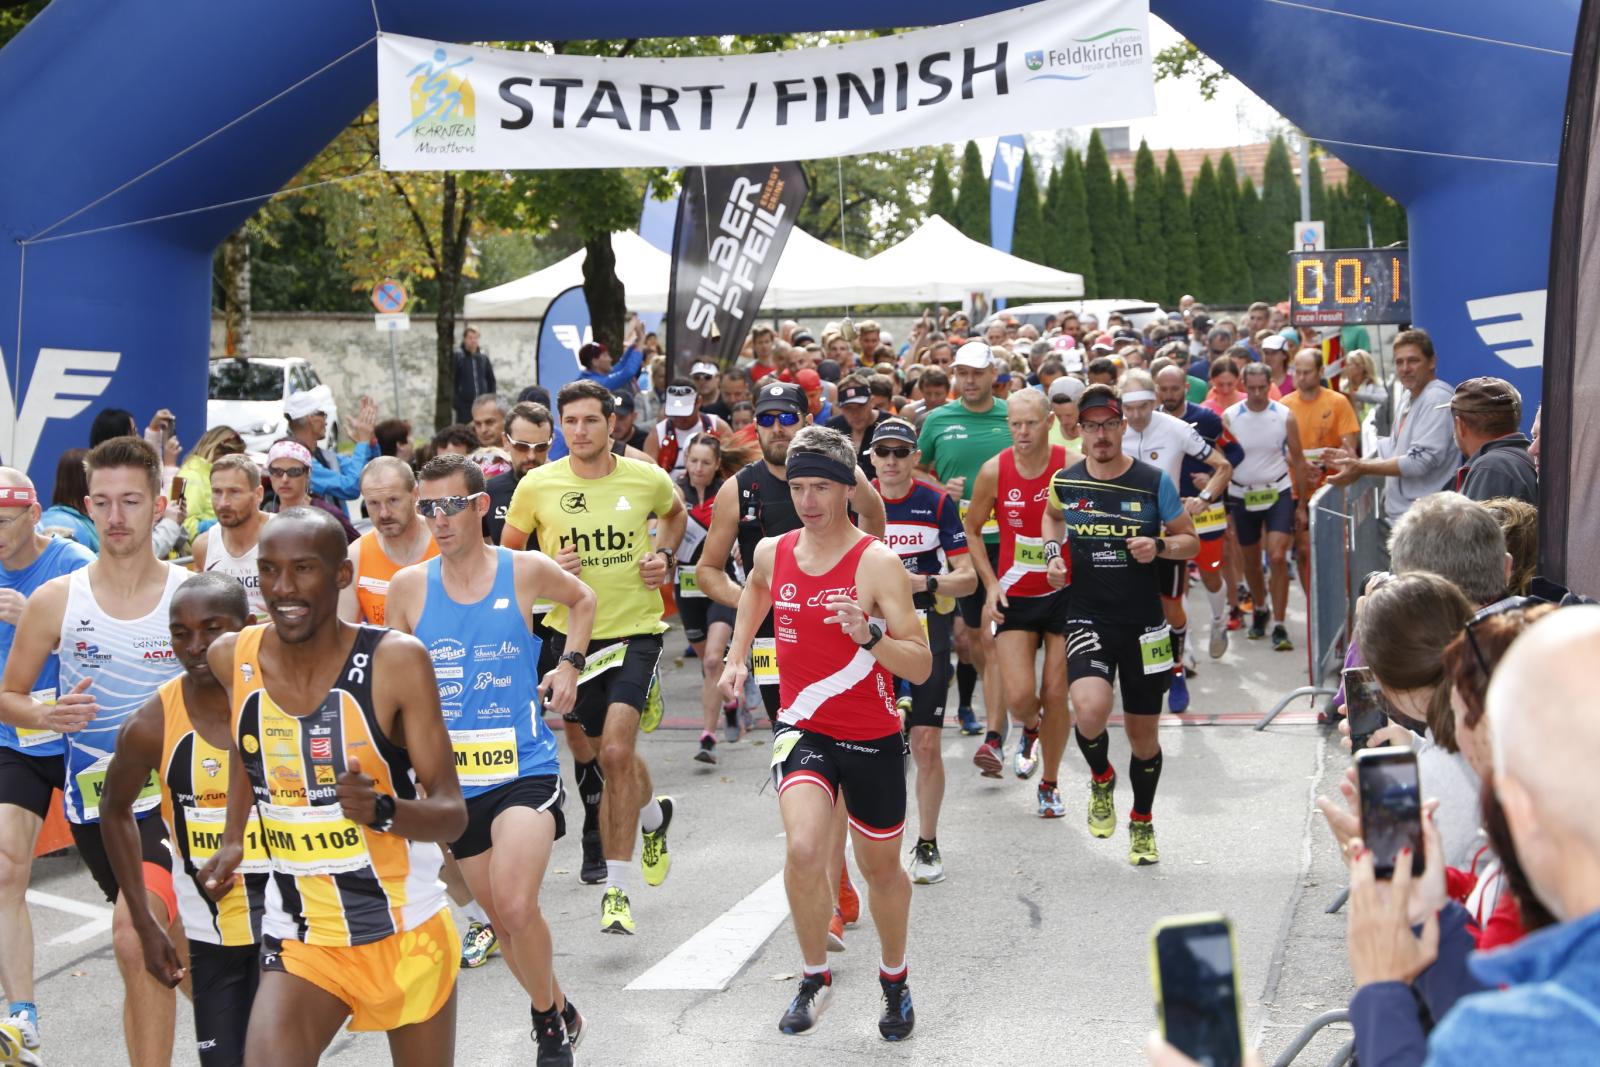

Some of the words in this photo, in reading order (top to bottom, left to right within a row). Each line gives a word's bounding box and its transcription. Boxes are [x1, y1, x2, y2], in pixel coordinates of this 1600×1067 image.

[1049, 42, 1144, 67] Feldkirchen
[499, 77, 725, 131] START
[736, 82, 758, 130] /
[773, 41, 1010, 127] FINISH
[760, 165, 780, 207] ENERGY
[767, 180, 785, 210] DRINK
[686, 177, 762, 338] SILBER
[723, 203, 786, 320] PFEIL
[559, 525, 635, 553] rhtb:
[1075, 524, 1142, 537] WSUT
[602, 552, 633, 568] gmbh
[754, 655, 770, 668] HM
[453, 751, 468, 766] M
[472, 749, 514, 766] 1029
[192, 830, 223, 850] HM
[266, 828, 297, 852] HM
[301, 827, 360, 851] 1108
